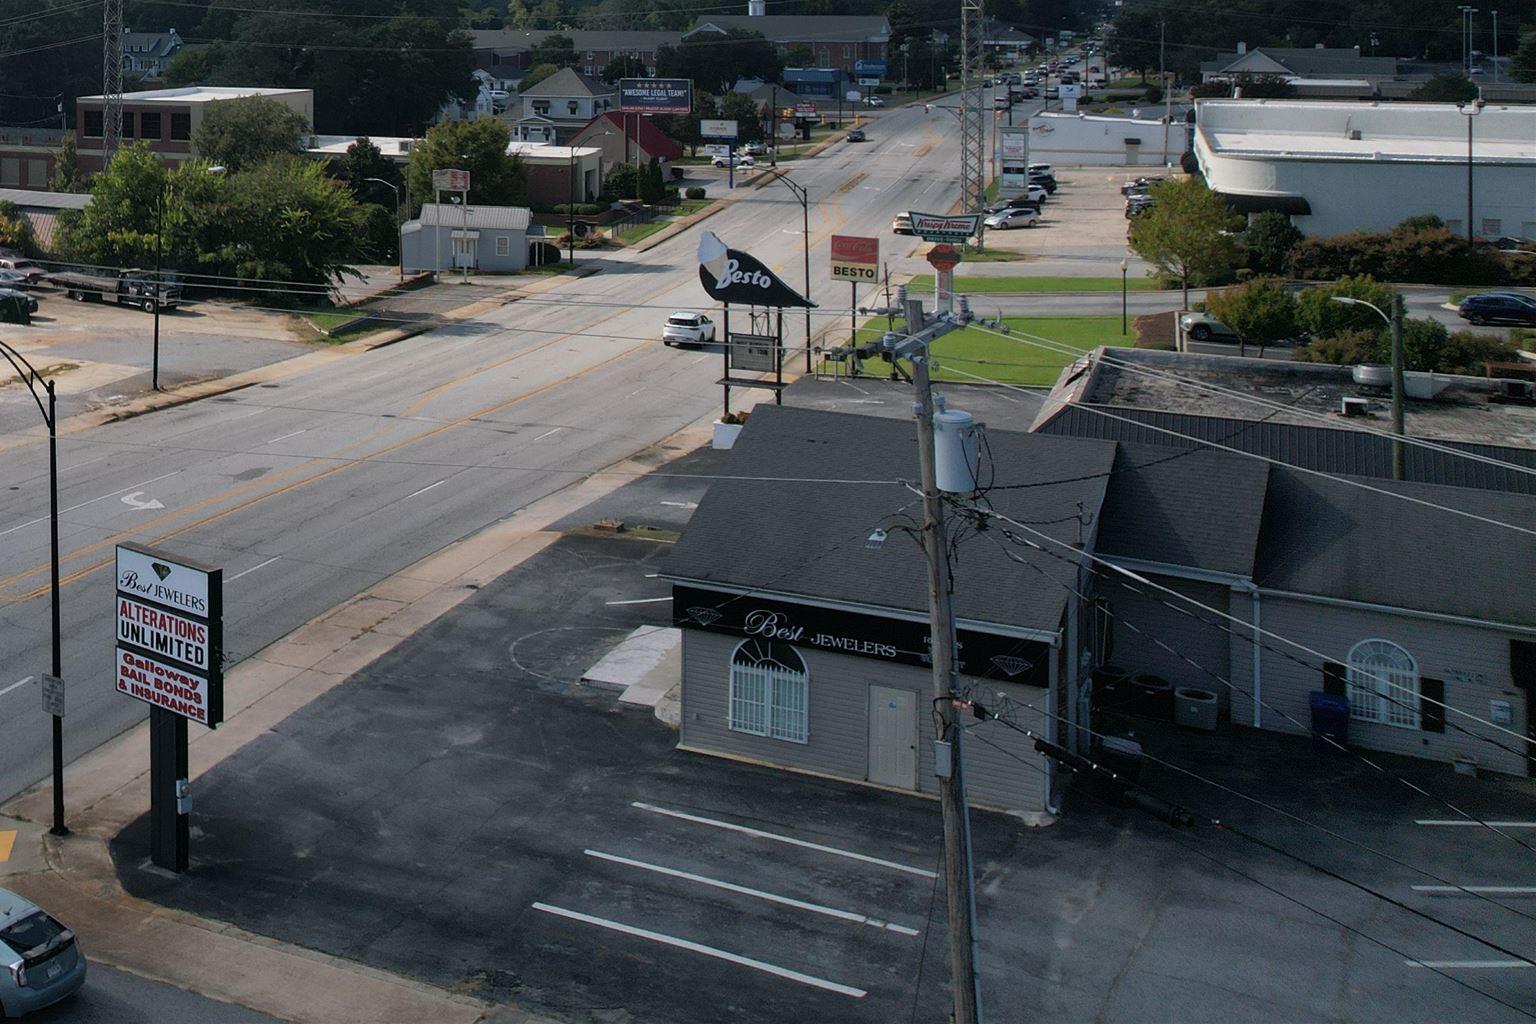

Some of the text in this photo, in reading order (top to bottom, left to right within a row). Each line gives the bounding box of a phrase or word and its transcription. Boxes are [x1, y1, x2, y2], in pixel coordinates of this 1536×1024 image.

[651, 89, 667, 97] LEGAL
[916, 218, 943, 230] Krispy
[715, 259, 772, 290] Besto
[833, 266, 874, 278] BESTO
[120, 570, 206, 612] Best JEWELERS
[120, 600, 206, 644] ALTERATIONS
[743, 609, 806, 642] Best
[810, 633, 897, 658] JEWELERS
[121, 620, 204, 666] UNLIMITED
[120, 665, 202, 704] BAIL BONDS
[122, 652, 200, 690] Galloway
[118, 678, 206, 721] & INSURANCE
